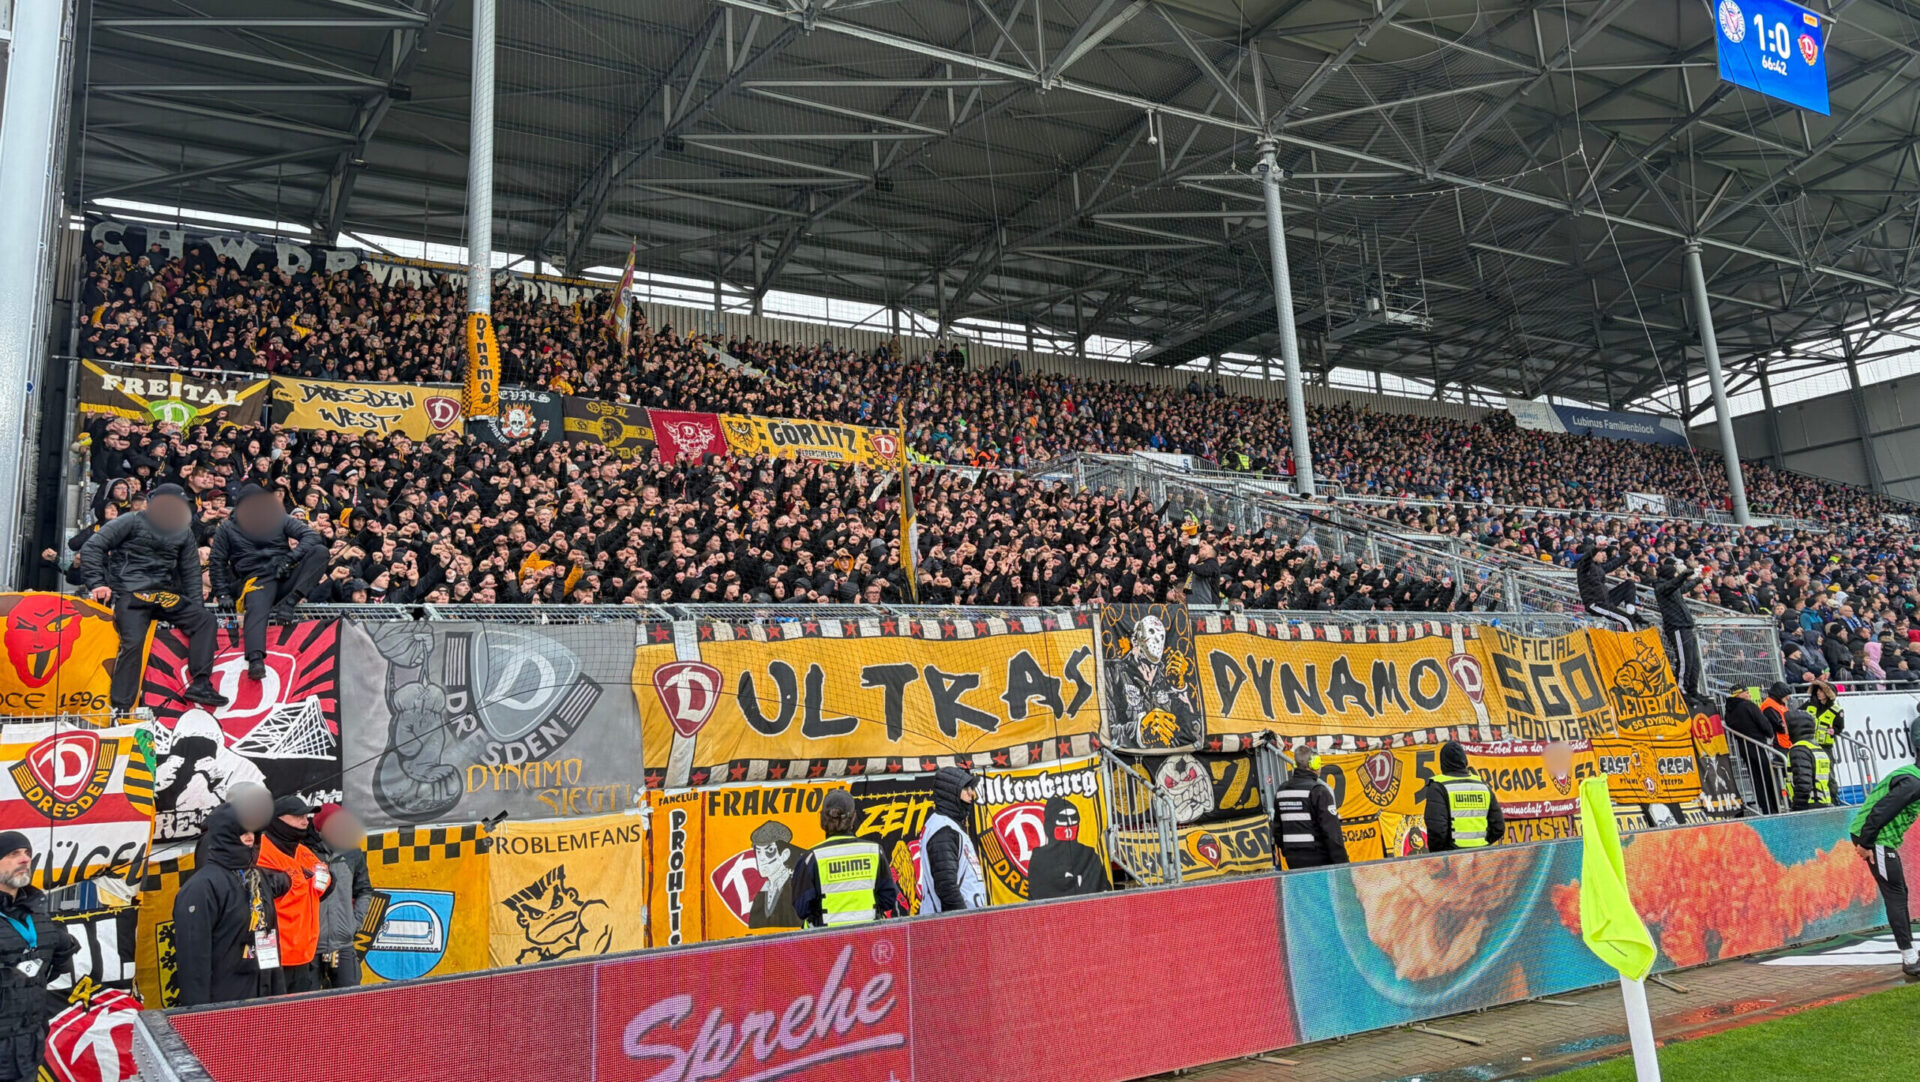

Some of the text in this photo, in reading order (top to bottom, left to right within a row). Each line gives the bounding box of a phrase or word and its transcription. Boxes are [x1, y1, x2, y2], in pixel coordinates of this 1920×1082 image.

[1753, 13, 1791, 59] 1:0
[1761, 54, 1787, 76] 66:42
[476, 318, 493, 394] Dynamo
[101, 374, 243, 406] FREITAL
[298, 383, 416, 409] DRESDEN
[498, 389, 551, 403] EVILS
[317, 406, 402, 433] WEST
[1572, 415, 1655, 434] Lubinus Familienblock
[767, 420, 858, 454] GÖRLITZ
[1495, 629, 1576, 661] OFFICIAL
[736, 645, 1094, 742] ULTRAS
[1209, 648, 1449, 720] DYNAMO
[446, 691, 568, 767] DRESDEN
[1506, 706, 1614, 742] HOOLIGANS
[466, 758, 583, 793] DYNAMO
[1599, 755, 1631, 774] EAST
[26, 768, 110, 818] DRESDEN
[658, 791, 699, 806] FANCLUB
[708, 785, 845, 817] FRAKTIO
[1363, 778, 1400, 806] DRESDEN
[856, 796, 936, 840] ZEIT
[485, 823, 641, 855] PROBLEMFANS
[622, 944, 895, 1082] Sprehe
